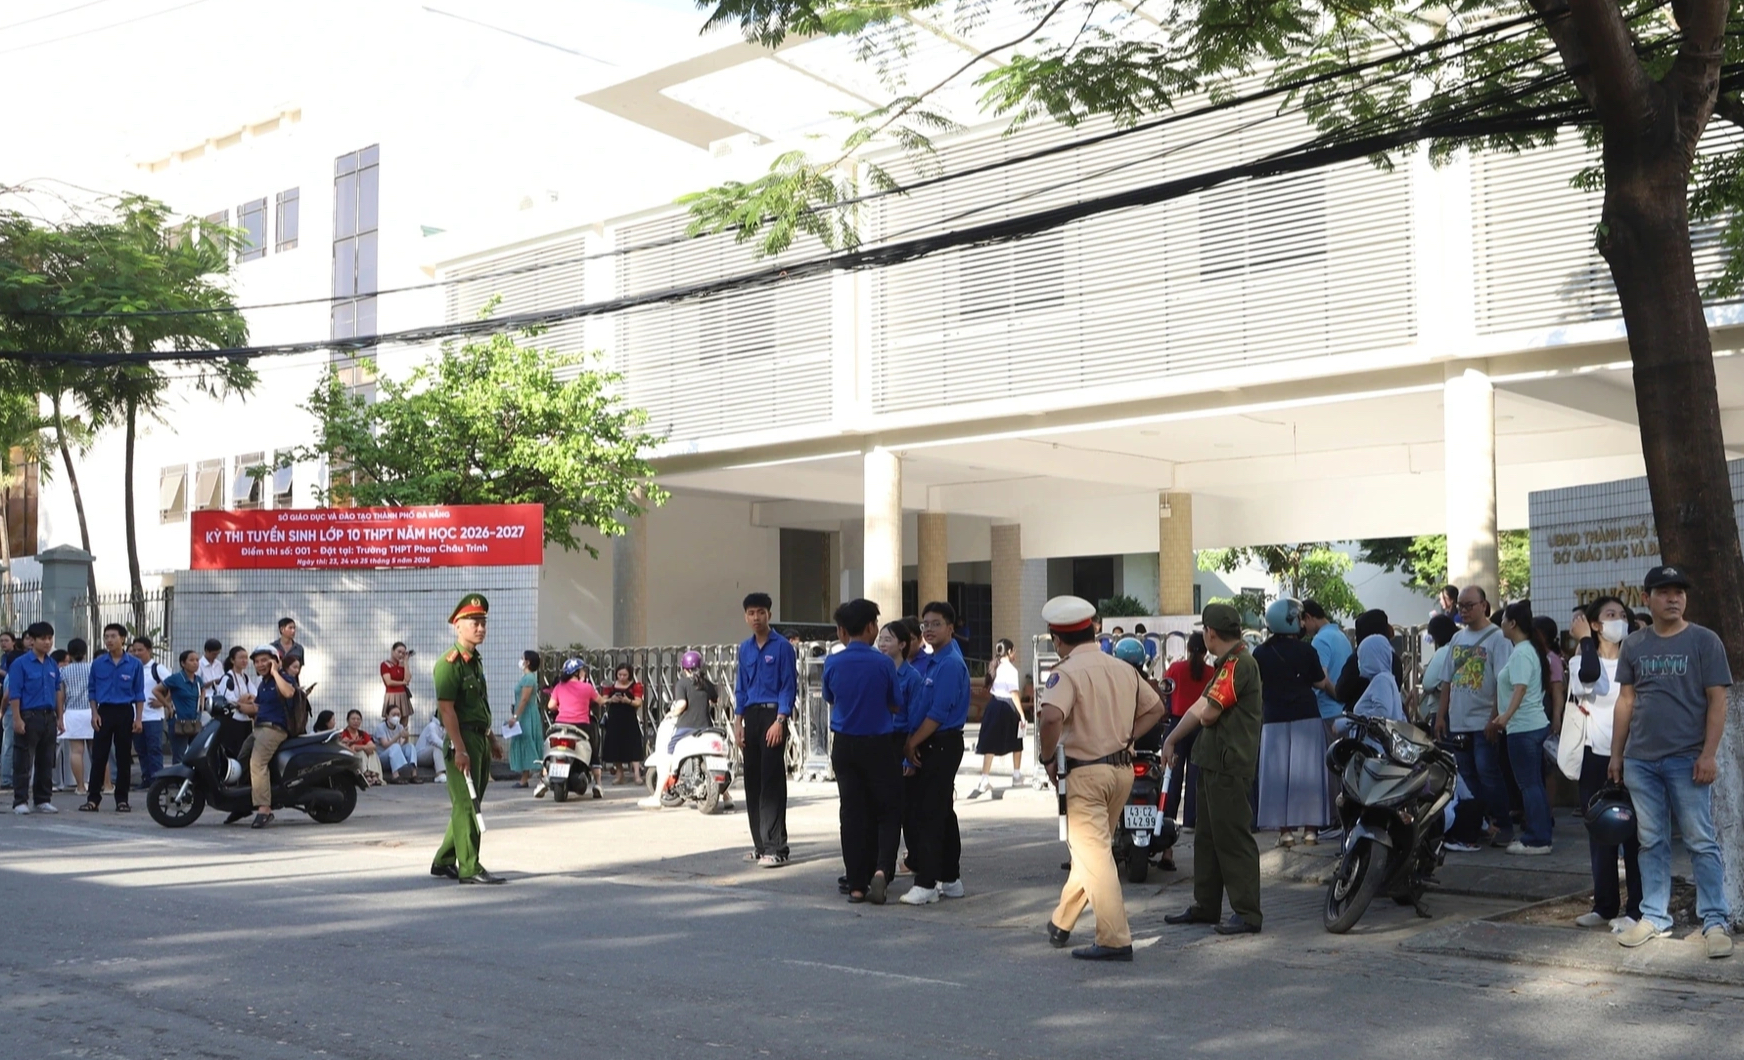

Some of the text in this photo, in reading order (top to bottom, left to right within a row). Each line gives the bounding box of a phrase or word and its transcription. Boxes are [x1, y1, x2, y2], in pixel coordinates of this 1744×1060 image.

[278, 509, 450, 523] SỞ GIÁO DỤC VÀ ĐÀO TẠO THÀNH PHỐ ĐÀ NẴNG
[206, 525, 525, 543] KỲ THI TUYỂN SINH LỚP 10 THPT NĂM HỌC 2026-2027
[1548, 533, 1580, 548] UBND
[1583, 526, 1622, 544] THÀNH
[1623, 520, 1648, 540] PHỐ
[242, 546, 264, 556] Điểm
[266, 547, 278, 555] thi
[280, 546, 293, 555] số:
[295, 546, 311, 555] 001
[320, 546, 336, 556] Đặt
[339, 546, 354, 556] tại:
[356, 546, 387, 556] Trường
[389, 545, 412, 554] THPT
[414, 545, 437, 553] Phan
[439, 544, 463, 553] Châu
[466, 544, 488, 552] Trinh
[1573, 545, 1603, 563] GIÁO
[1604, 545, 1628, 563] DỤC
[1630, 540, 1647, 557] VÀ
[1128, 817, 1156, 827] 142.99
